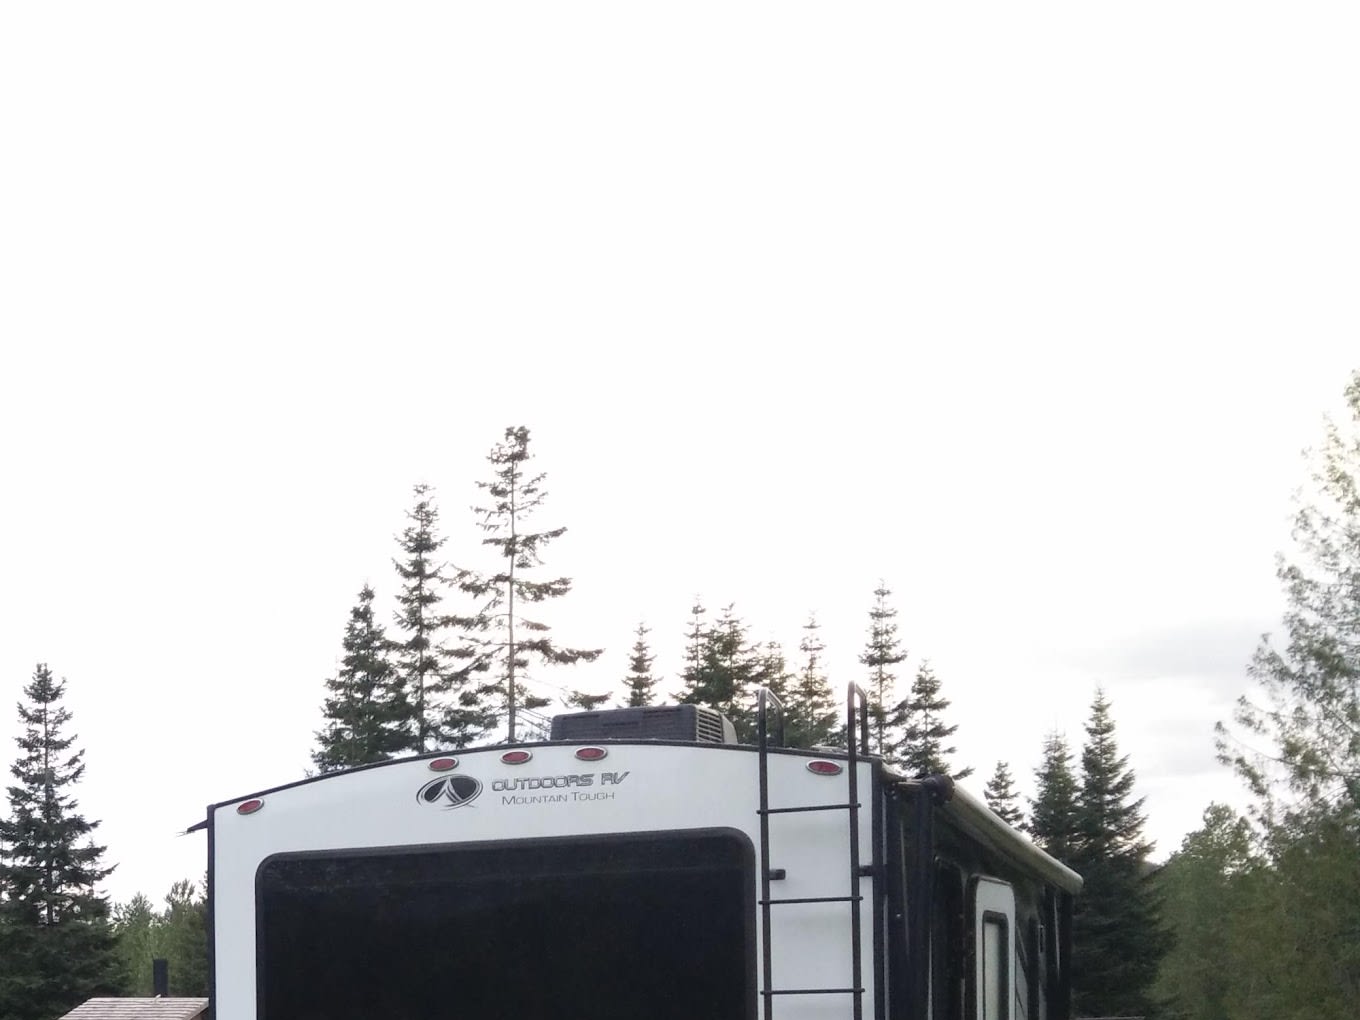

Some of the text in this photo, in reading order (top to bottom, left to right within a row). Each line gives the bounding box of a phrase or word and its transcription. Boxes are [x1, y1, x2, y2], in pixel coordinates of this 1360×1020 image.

[492, 771, 630, 792] OUTDOORS RV
[502, 791, 615, 805] MOUNTAIN TOUGH
